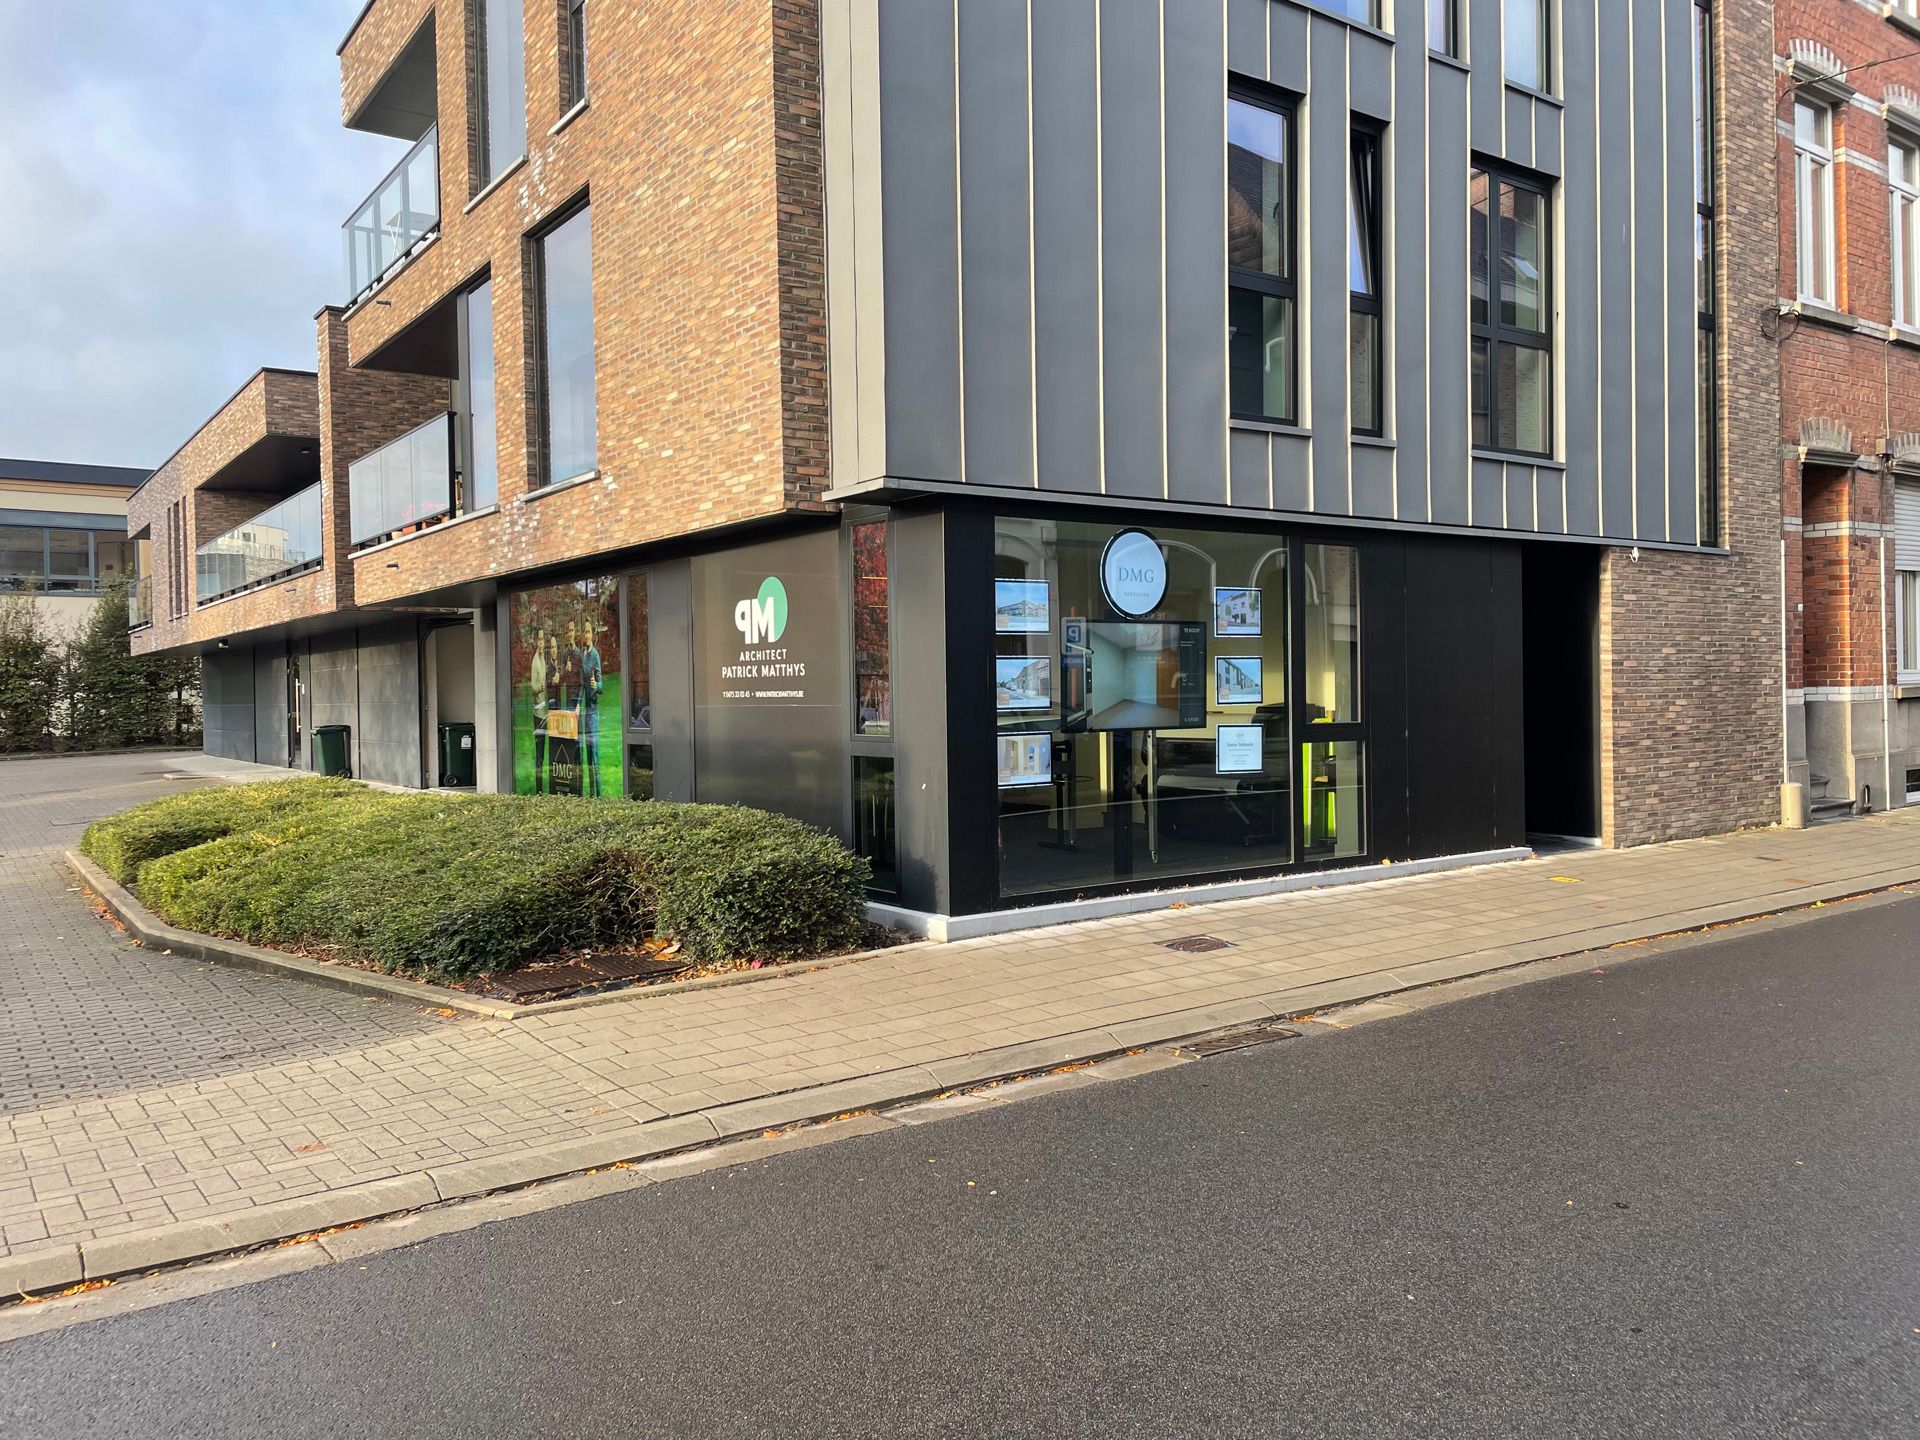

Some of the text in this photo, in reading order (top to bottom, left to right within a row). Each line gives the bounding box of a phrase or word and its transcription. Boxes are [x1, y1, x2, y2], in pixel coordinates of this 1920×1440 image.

[1119, 567, 1154, 583] DMG
[739, 649, 787, 662] ARCHITECT
[721, 663, 806, 679] PATRICK MATTHYS
[552, 762, 573, 779] DMG
